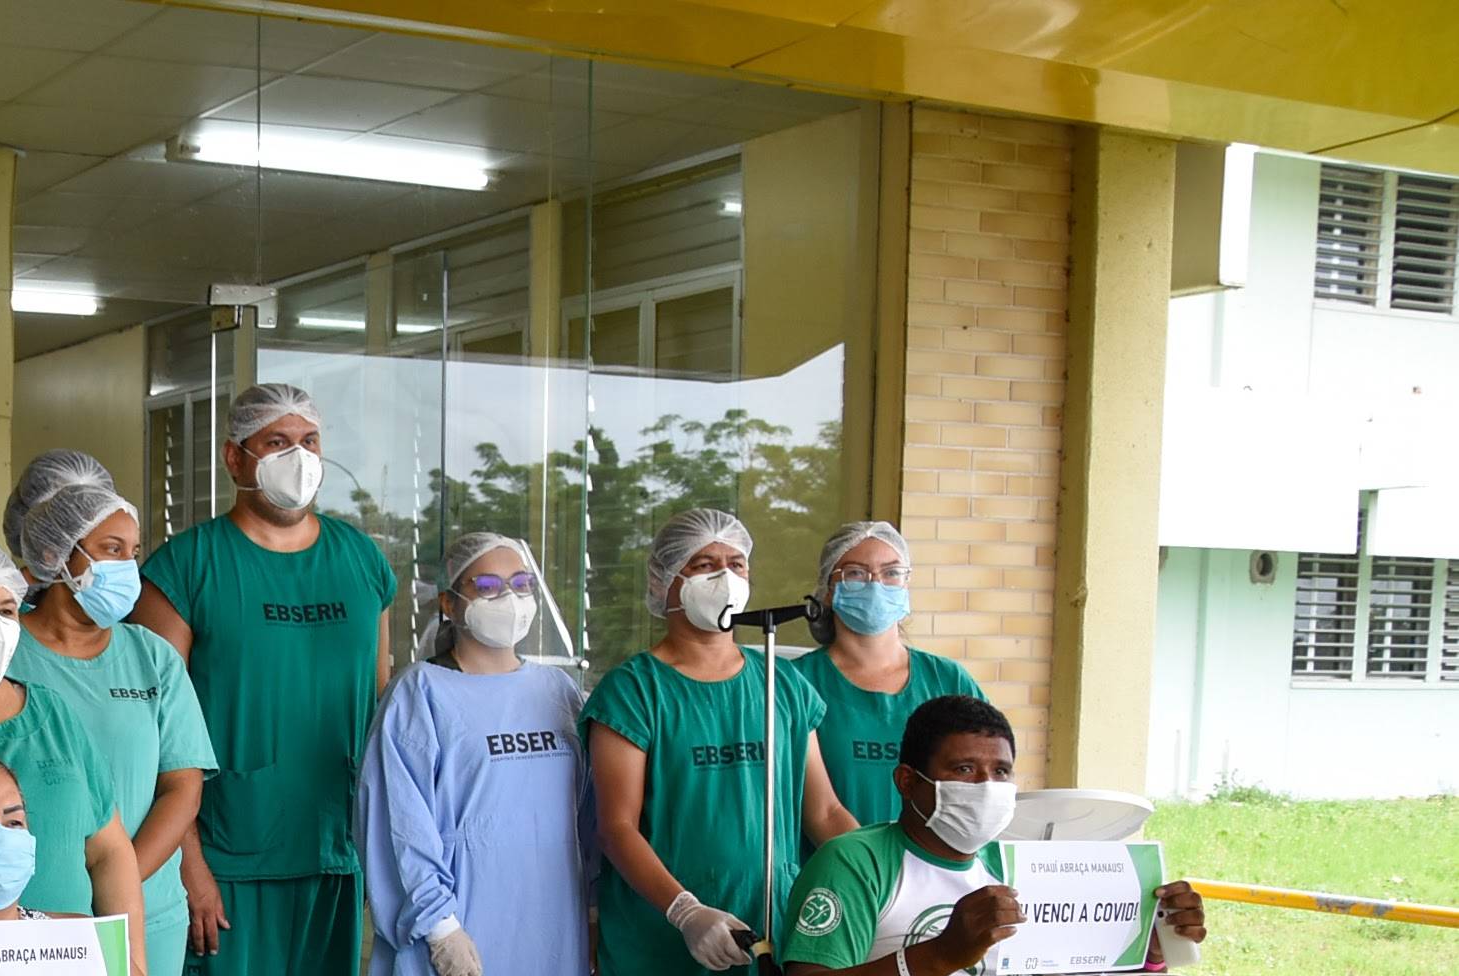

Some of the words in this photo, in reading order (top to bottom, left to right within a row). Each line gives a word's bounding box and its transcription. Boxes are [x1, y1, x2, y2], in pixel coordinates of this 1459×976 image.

[262, 601, 347, 623] EBSERH
[852, 741, 899, 761] EBS
[1030, 862, 1037, 873] O
[1038, 860, 1059, 874] PIAUÍ
[1059, 862, 1089, 875] ABRAÇA
[1090, 862, 1125, 873] MANAUS!
[1033, 903, 1075, 923] VENCI
[1078, 903, 1088, 922] A
[1093, 902, 1139, 922] COVID!
[40, 946, 87, 960] MANAUS!
[1069, 956, 1106, 965] EBSERH
